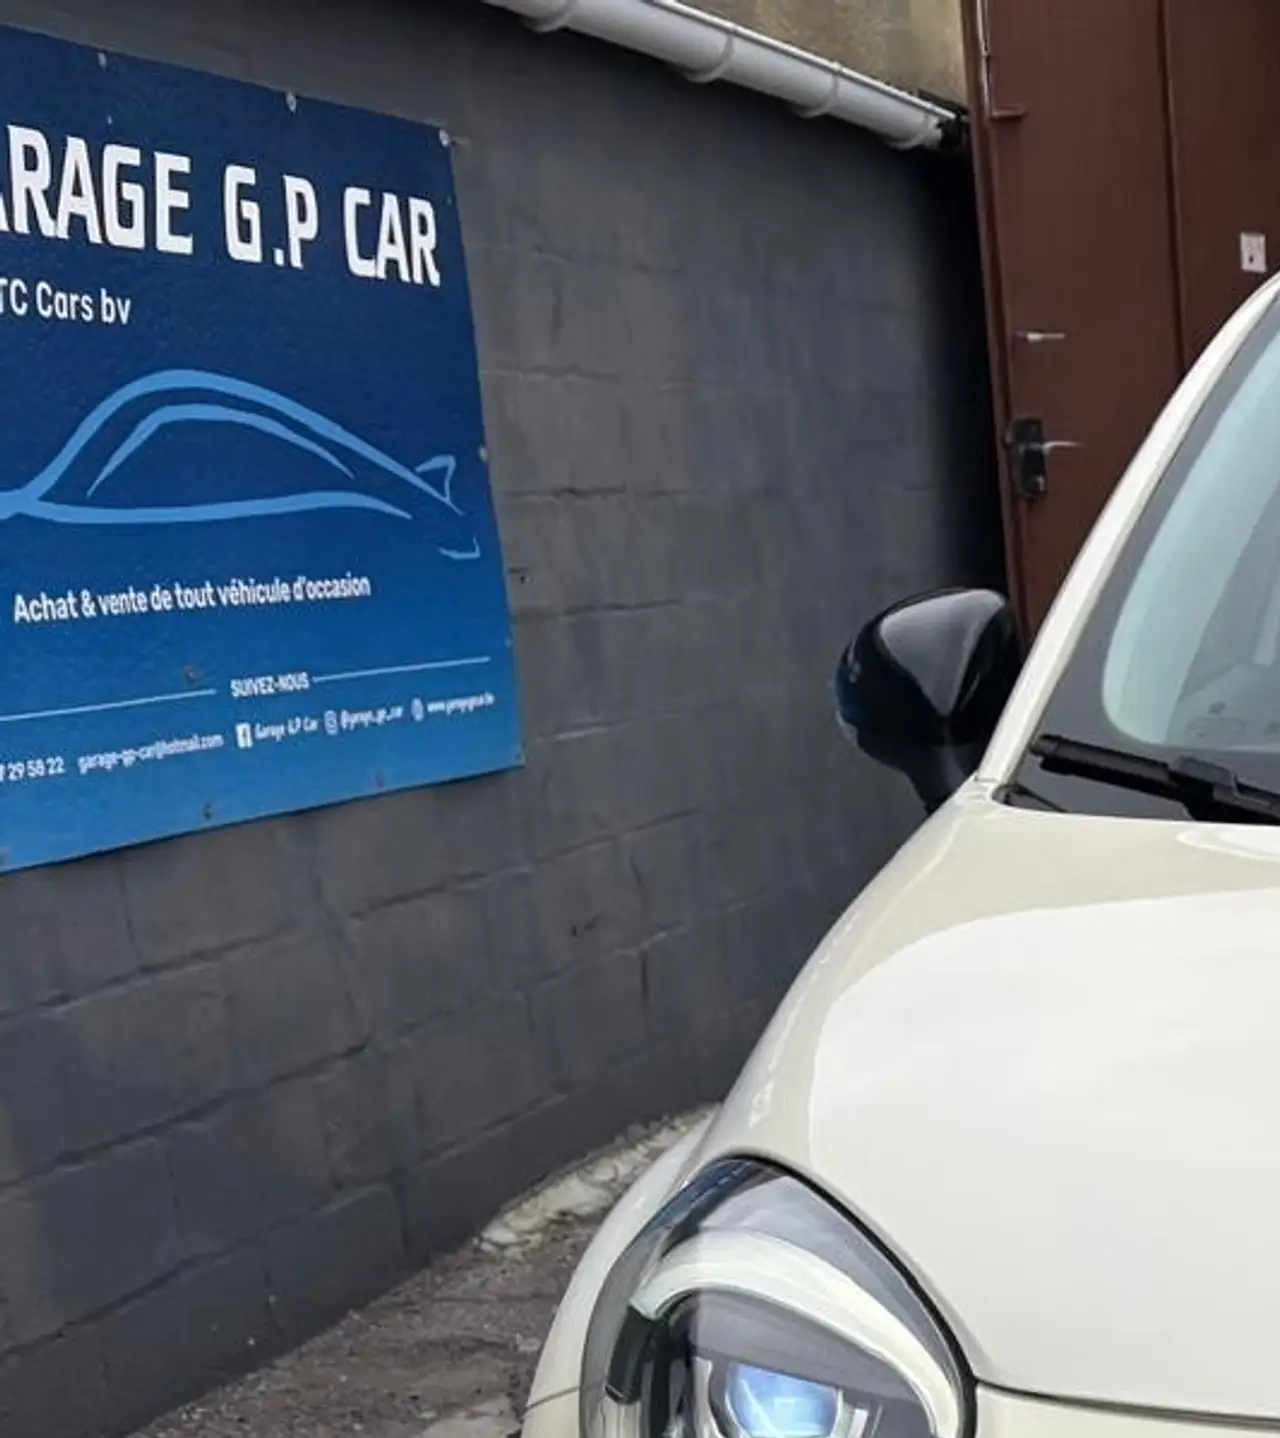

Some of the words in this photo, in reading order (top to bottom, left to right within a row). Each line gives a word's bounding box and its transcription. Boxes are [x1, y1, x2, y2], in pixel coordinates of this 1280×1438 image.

[0, 124, 193, 255] RAGE
[223, 164, 319, 269] G.P
[344, 186, 441, 286] CAR
[36, 281, 94, 322] Cars
[100, 288, 131, 325] bv
[14, 588, 78, 624] Achat
[80, 588, 97, 618] &
[98, 585, 148, 616] vente
[150, 584, 173, 612] de
[174, 580, 217, 611] tout
[216, 575, 292, 606] véhicule
[292, 571, 372, 601] d'occasion
[230, 671, 310, 698] SUIVEZ-NOUS
[48, 756, 67, 775] 22
